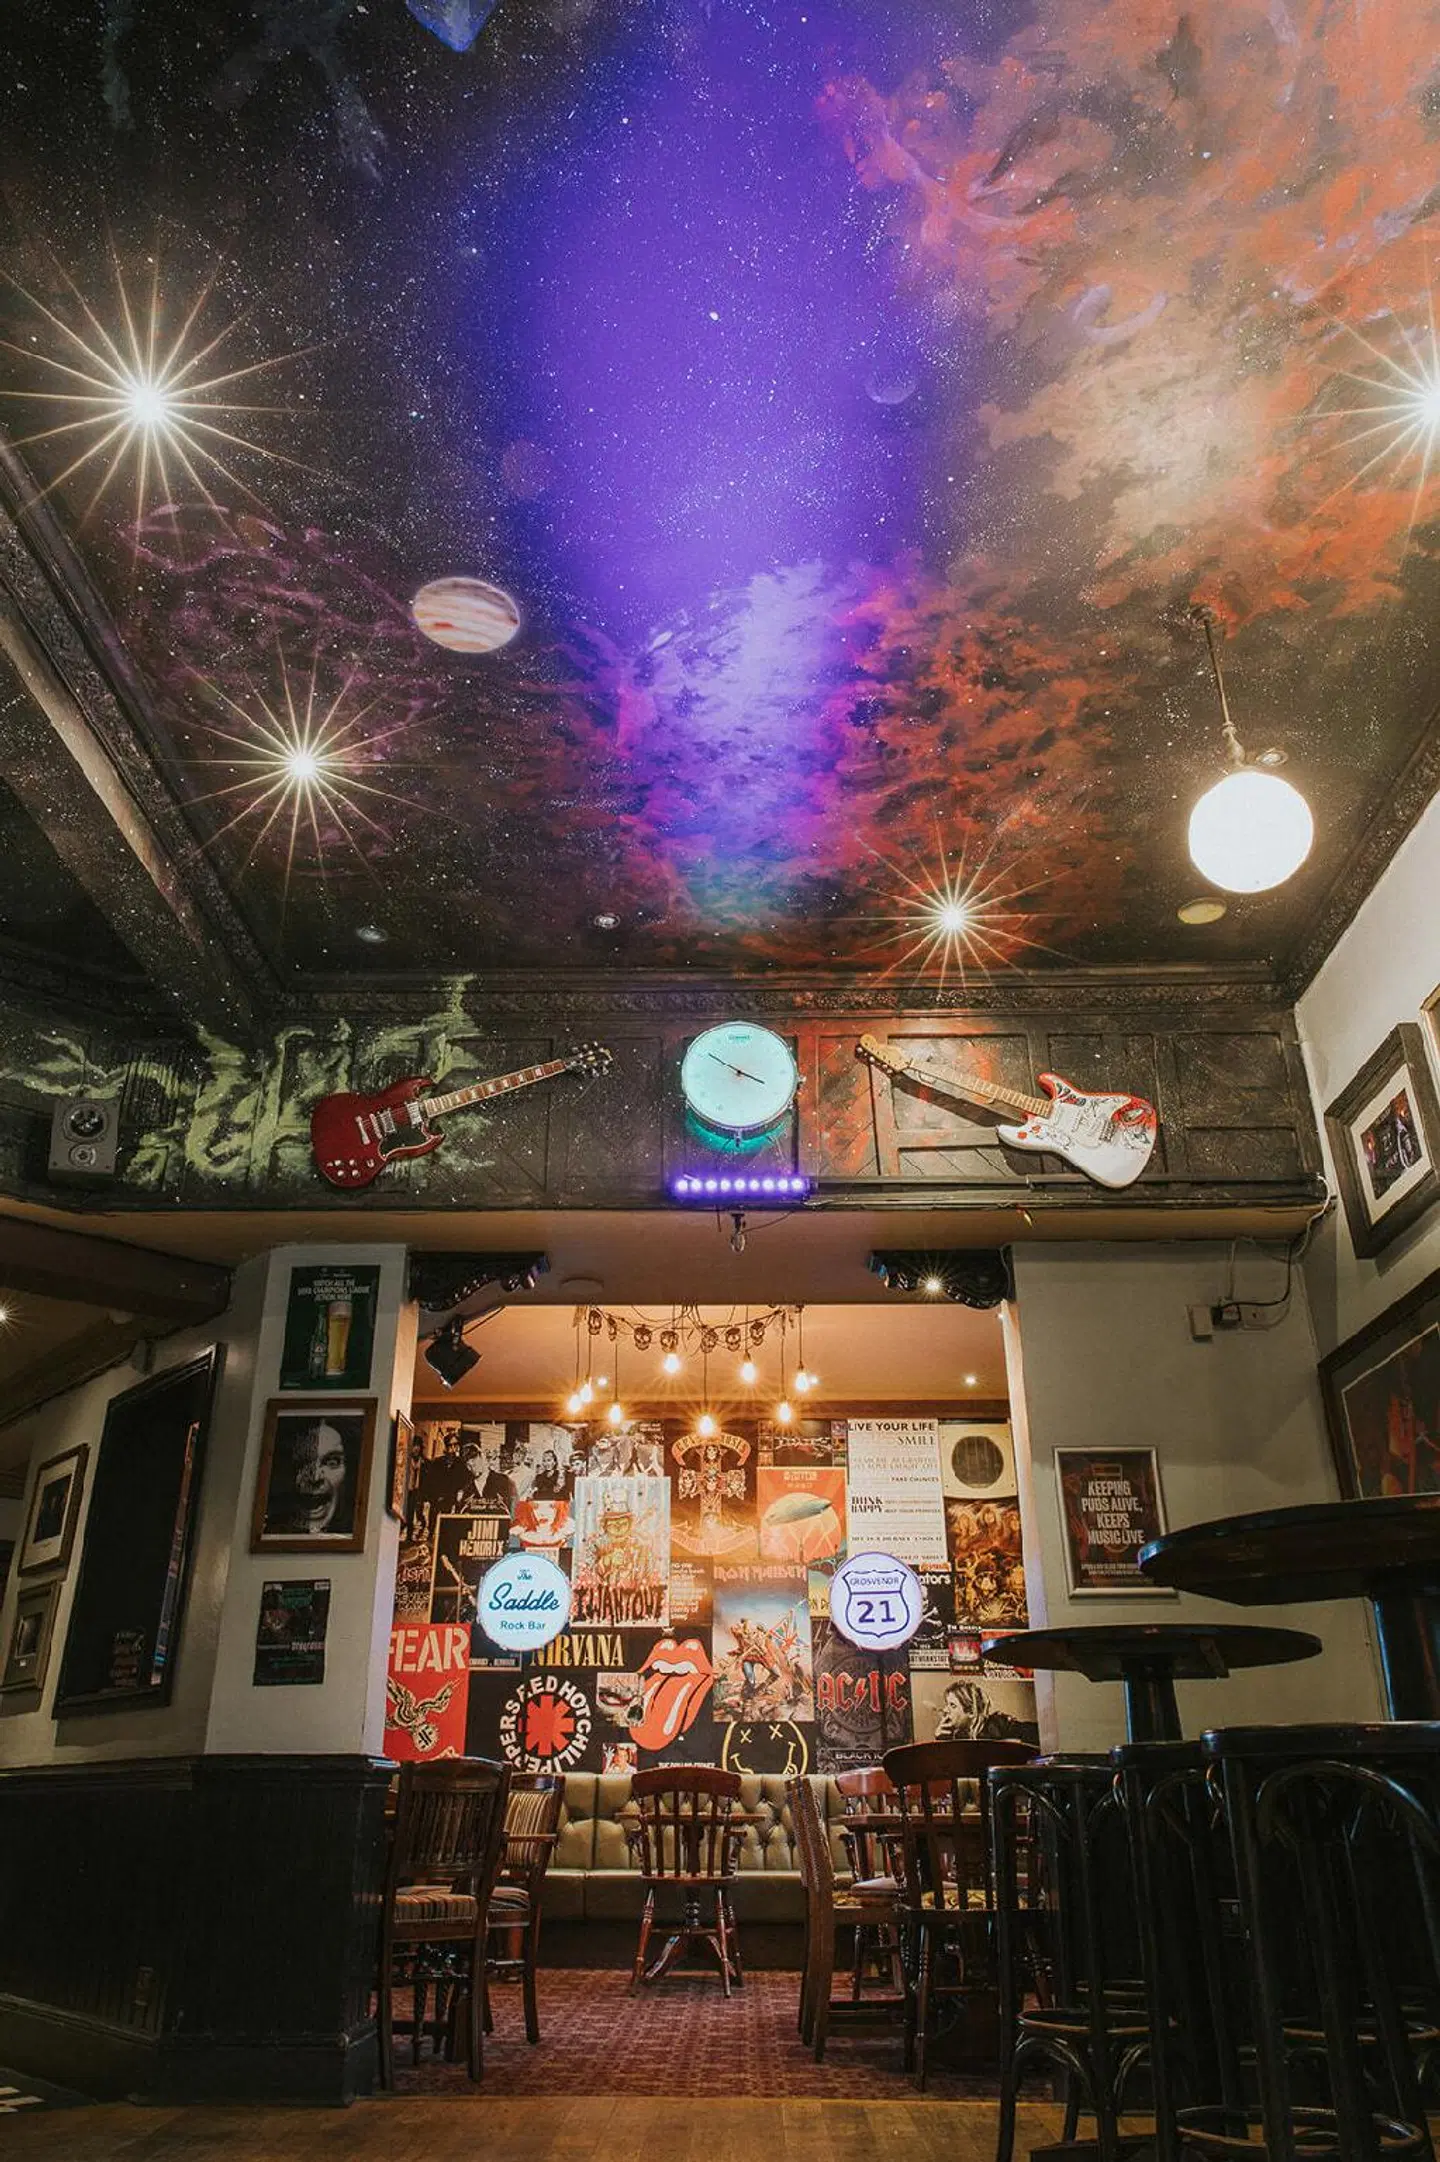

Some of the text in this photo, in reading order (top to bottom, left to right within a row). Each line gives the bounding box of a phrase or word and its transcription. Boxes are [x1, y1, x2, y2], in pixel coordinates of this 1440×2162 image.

[848, 1422, 935, 1432] LIVE YOUR LIFE
[1088, 1481, 1132, 1497] KEEPING
[1082, 1498, 1110, 1512] PUBS
[1097, 1513, 1131, 1529] KEEPS
[467, 1520, 500, 1540] JIMI
[1088, 1530, 1146, 1545] MUSIC LIVE
[459, 1540, 504, 1557] HENDRIX
[517, 1568, 533, 1580] The
[714, 1565, 807, 1582] IRON MAIDEN
[850, 1576, 899, 1586] GROSVENOR
[488, 1582, 560, 1610] Saddle
[857, 1600, 896, 1623] 21
[500, 1620, 546, 1631] Rock Bar
[558, 1680, 591, 1718] HOT
[553, 1718, 592, 1774] CHILI
